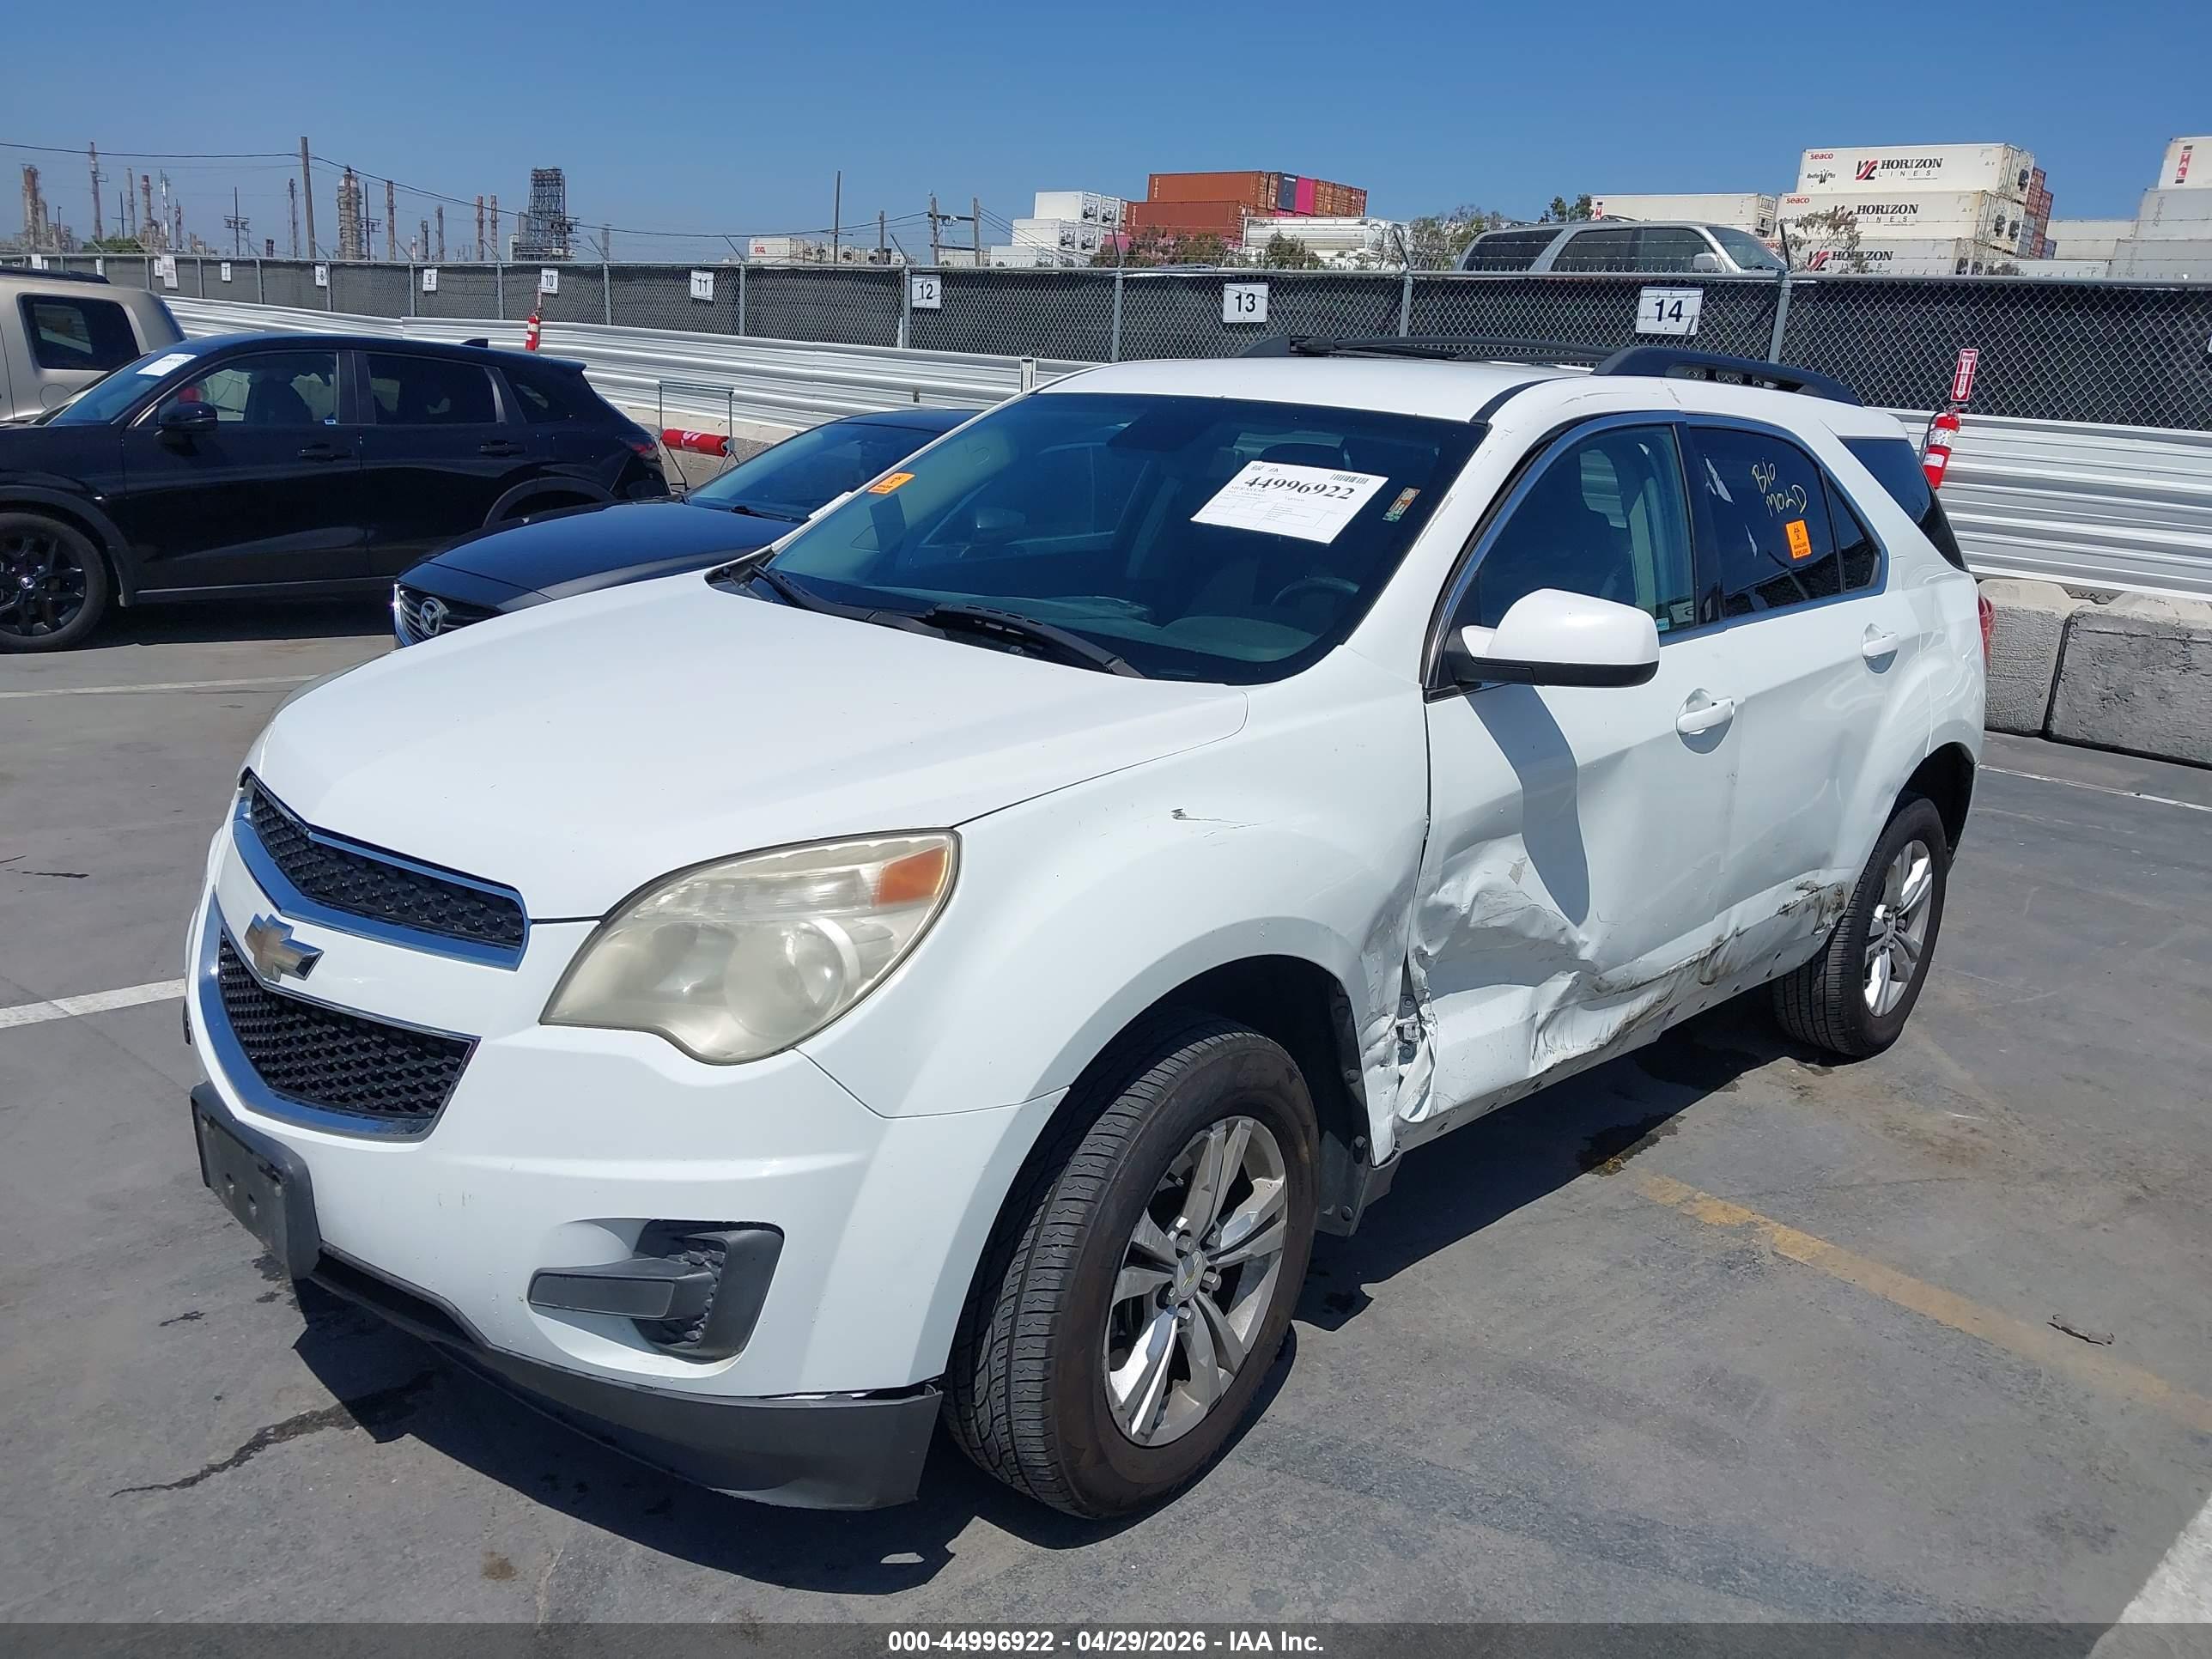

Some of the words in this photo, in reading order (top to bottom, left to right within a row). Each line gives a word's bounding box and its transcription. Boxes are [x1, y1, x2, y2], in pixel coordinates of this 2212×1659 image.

[1809, 151, 1834, 161] seaco
[1880, 158, 1943, 170] HORIZON
[1785, 196, 1810, 204] seaco
[1855, 204, 1919, 215] HORIZON
[319, 270, 325, 281] 8
[545, 275, 554, 287] 10
[698, 277, 708, 293] 11
[919, 283, 933, 300] 12
[1235, 292, 1256, 313] 13
[1655, 299, 1683, 323] 14
[1244, 476, 1356, 501] 44996922
[1765, 484, 1808, 517] MOLD
